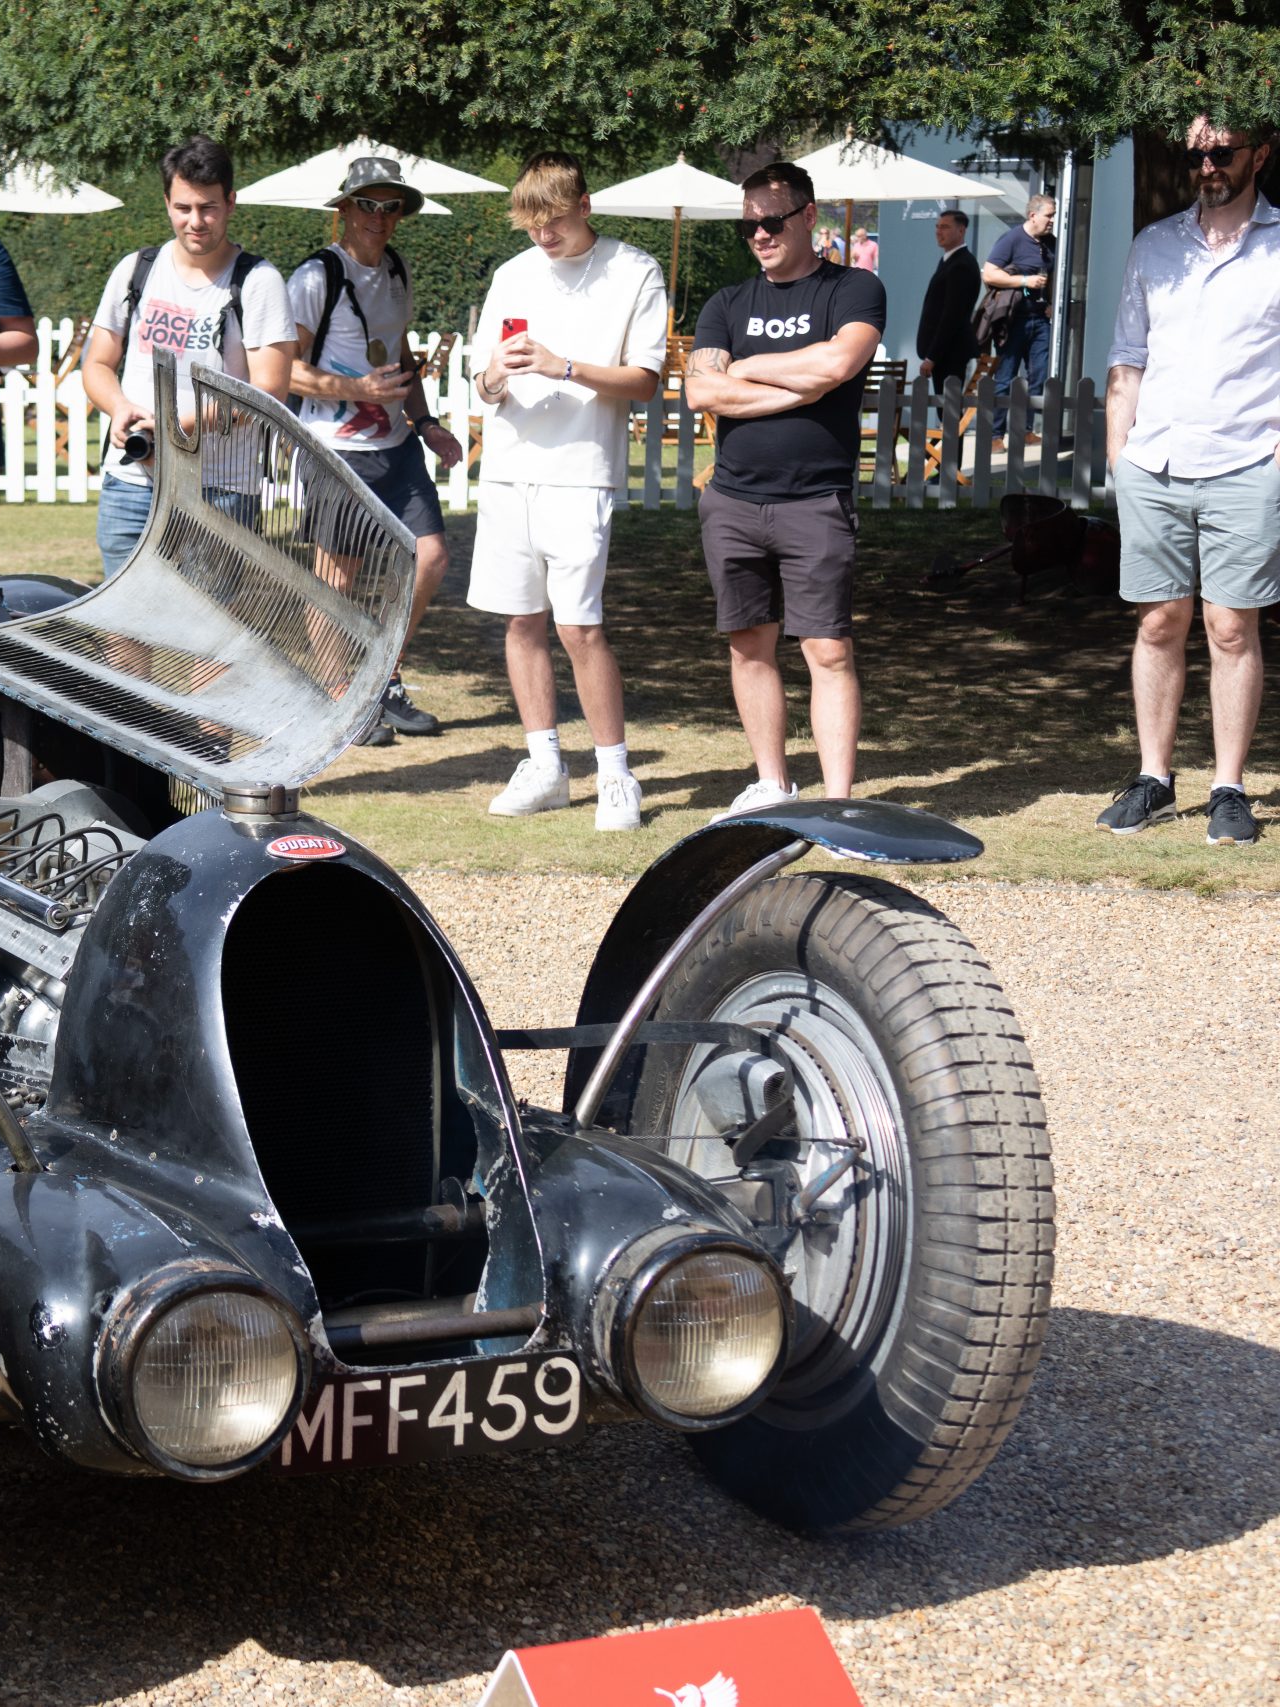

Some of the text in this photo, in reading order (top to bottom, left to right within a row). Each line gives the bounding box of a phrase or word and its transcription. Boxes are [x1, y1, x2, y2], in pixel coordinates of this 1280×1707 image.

[142, 326, 210, 349] JONES
[746, 314, 811, 339] BOSS
[277, 838, 340, 852] BUGATTI
[281, 1356, 581, 1466] MFF459
